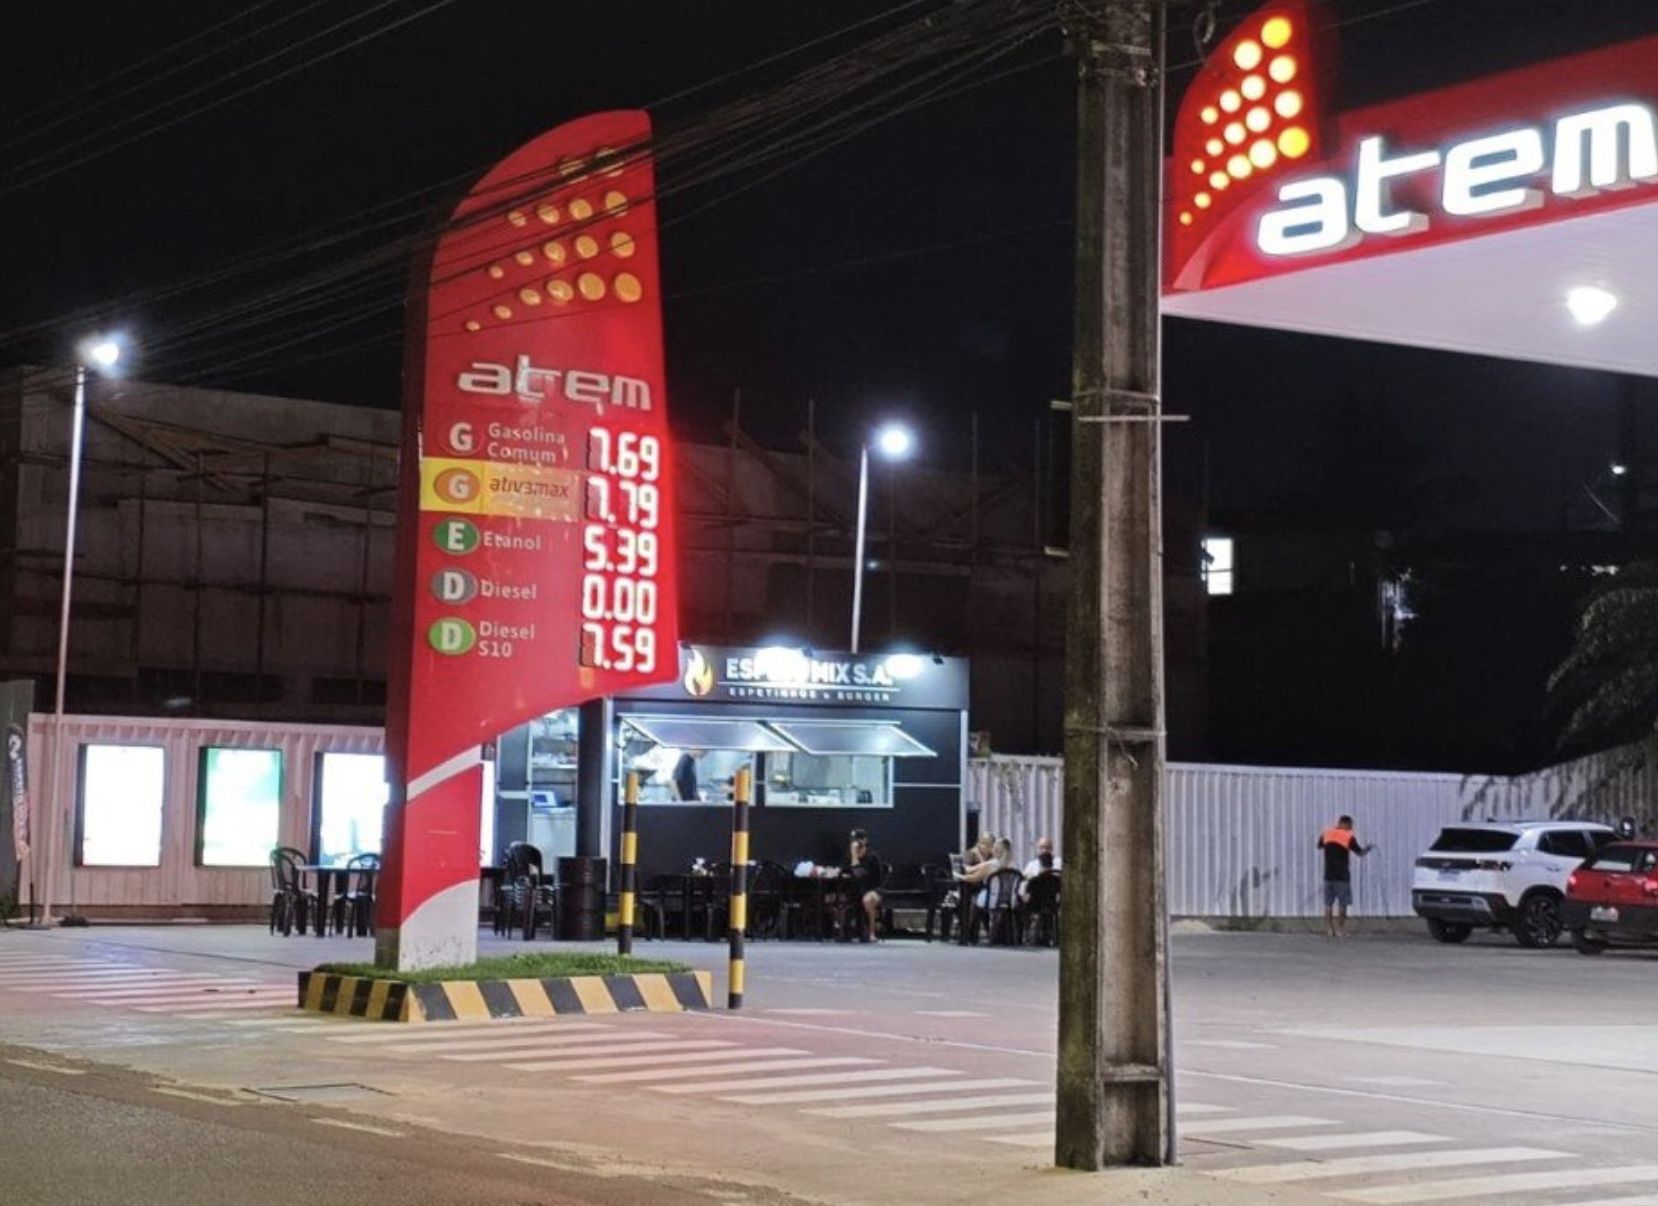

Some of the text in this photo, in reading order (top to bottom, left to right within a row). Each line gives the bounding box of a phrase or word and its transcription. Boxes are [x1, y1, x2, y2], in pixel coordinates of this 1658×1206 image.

[1256, 102, 1658, 256] atem
[456, 353, 651, 411] atem
[449, 422, 473, 451] G
[488, 422, 566, 445] Gasolina
[487, 441, 557, 462] Comum
[588, 426, 659, 481] 7.69
[449, 474, 470, 499] G
[587, 475, 659, 529] 7.79
[447, 521, 465, 551] E
[483, 531, 541, 550] Etanol
[584, 524, 658, 577] 5.39
[443, 571, 464, 600] D
[480, 578, 537, 600] Diesel
[582, 573, 657, 625] 0.00
[441, 622, 463, 651] D
[479, 620, 536, 639] Diesel
[478, 639, 512, 658] S10
[582, 622, 656, 674] 7.59
